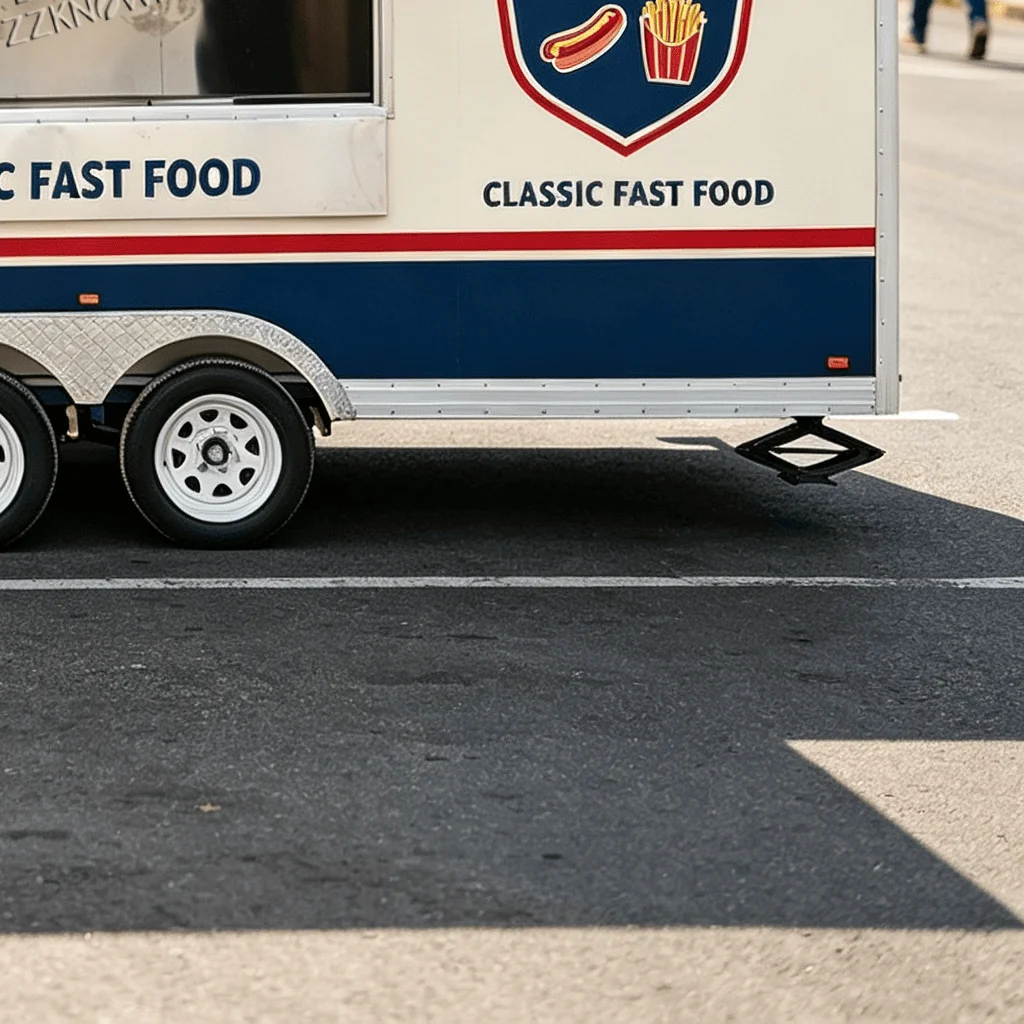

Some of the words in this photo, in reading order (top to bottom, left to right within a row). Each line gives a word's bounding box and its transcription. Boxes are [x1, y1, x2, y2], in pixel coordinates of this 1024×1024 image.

[30, 160, 131, 200] FAST
[144, 158, 261, 199] FOOD
[482, 180, 604, 208] CLASSIC
[613, 180, 684, 207] FAST
[693, 179, 775, 207] FOOD
